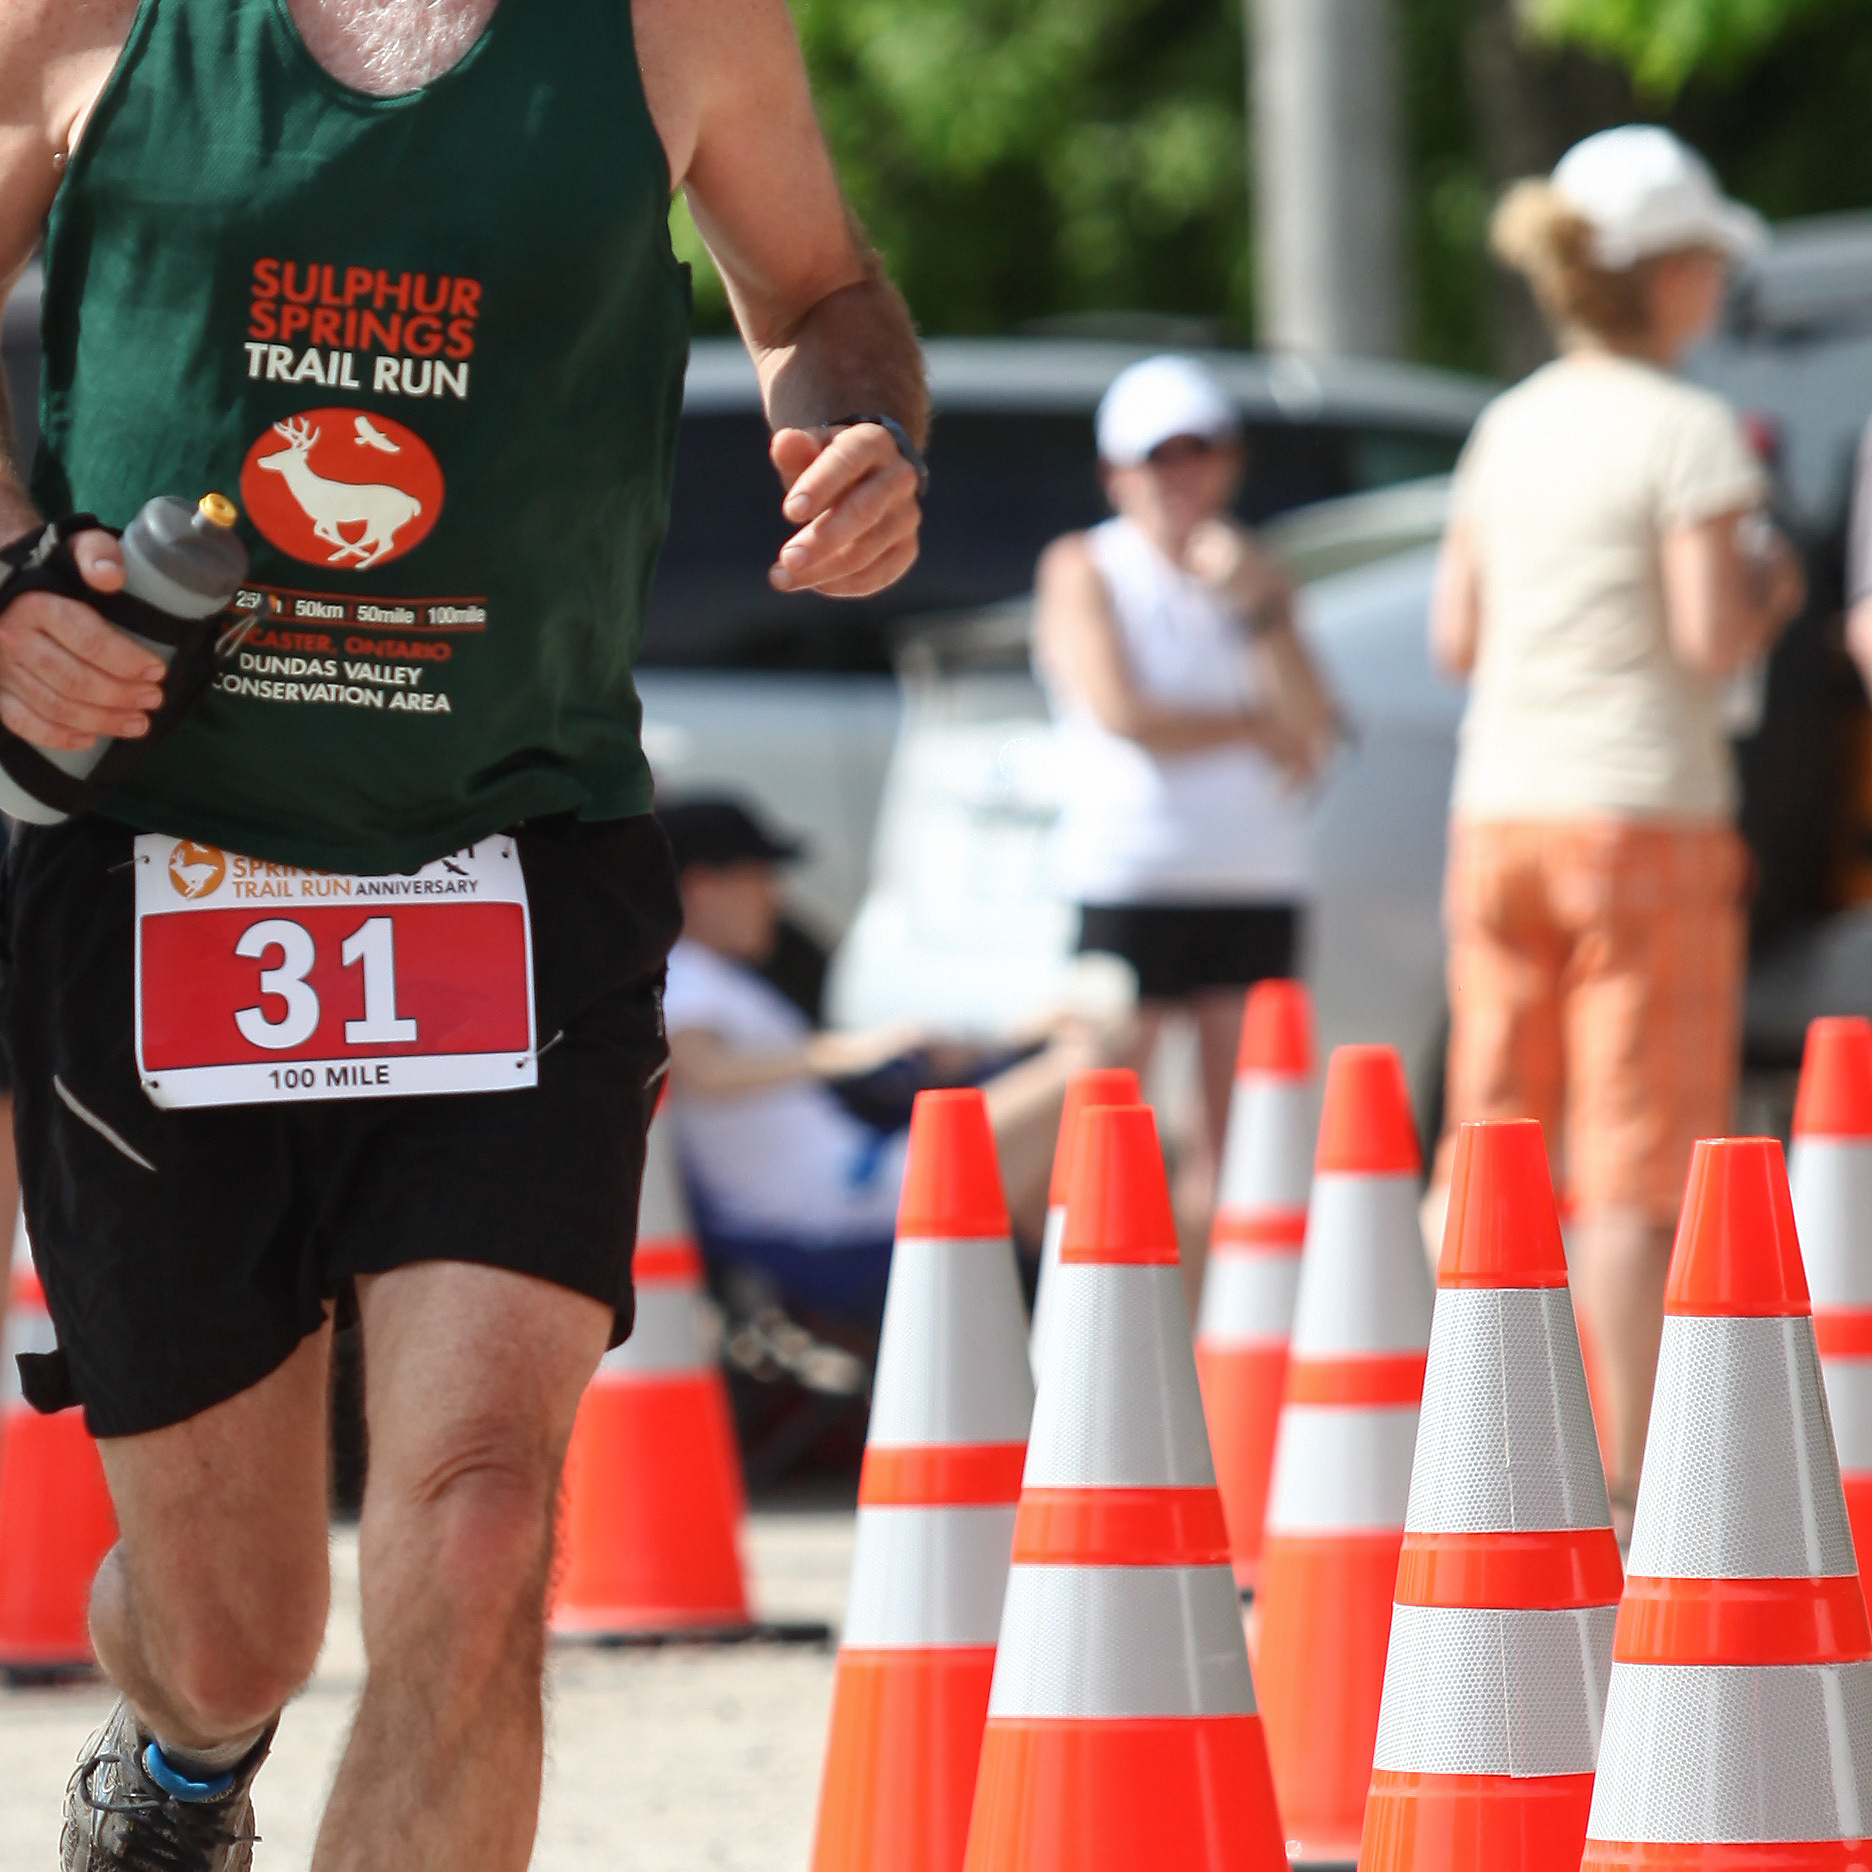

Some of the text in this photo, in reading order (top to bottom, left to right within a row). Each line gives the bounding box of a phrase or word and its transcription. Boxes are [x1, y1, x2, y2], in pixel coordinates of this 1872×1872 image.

[251, 257, 481, 318] SULPHUR
[247, 299, 476, 359] SPRINGS
[244, 340, 469, 400] TRAIL RUN
[295, 600, 344, 620] 50km
[357, 605, 415, 625] 50mile
[428, 605, 486, 625] 100mile
[343, 635, 452, 662] ONTARIO
[239, 652, 423, 686] DUNDAS VALLEY
[389, 691, 452, 713] AREA
[233, 879, 479, 898] TRAIL RUN ANNIVERSARY
[233, 916, 418, 1050] 31
[268, 1065, 390, 1090] 100 MILE
